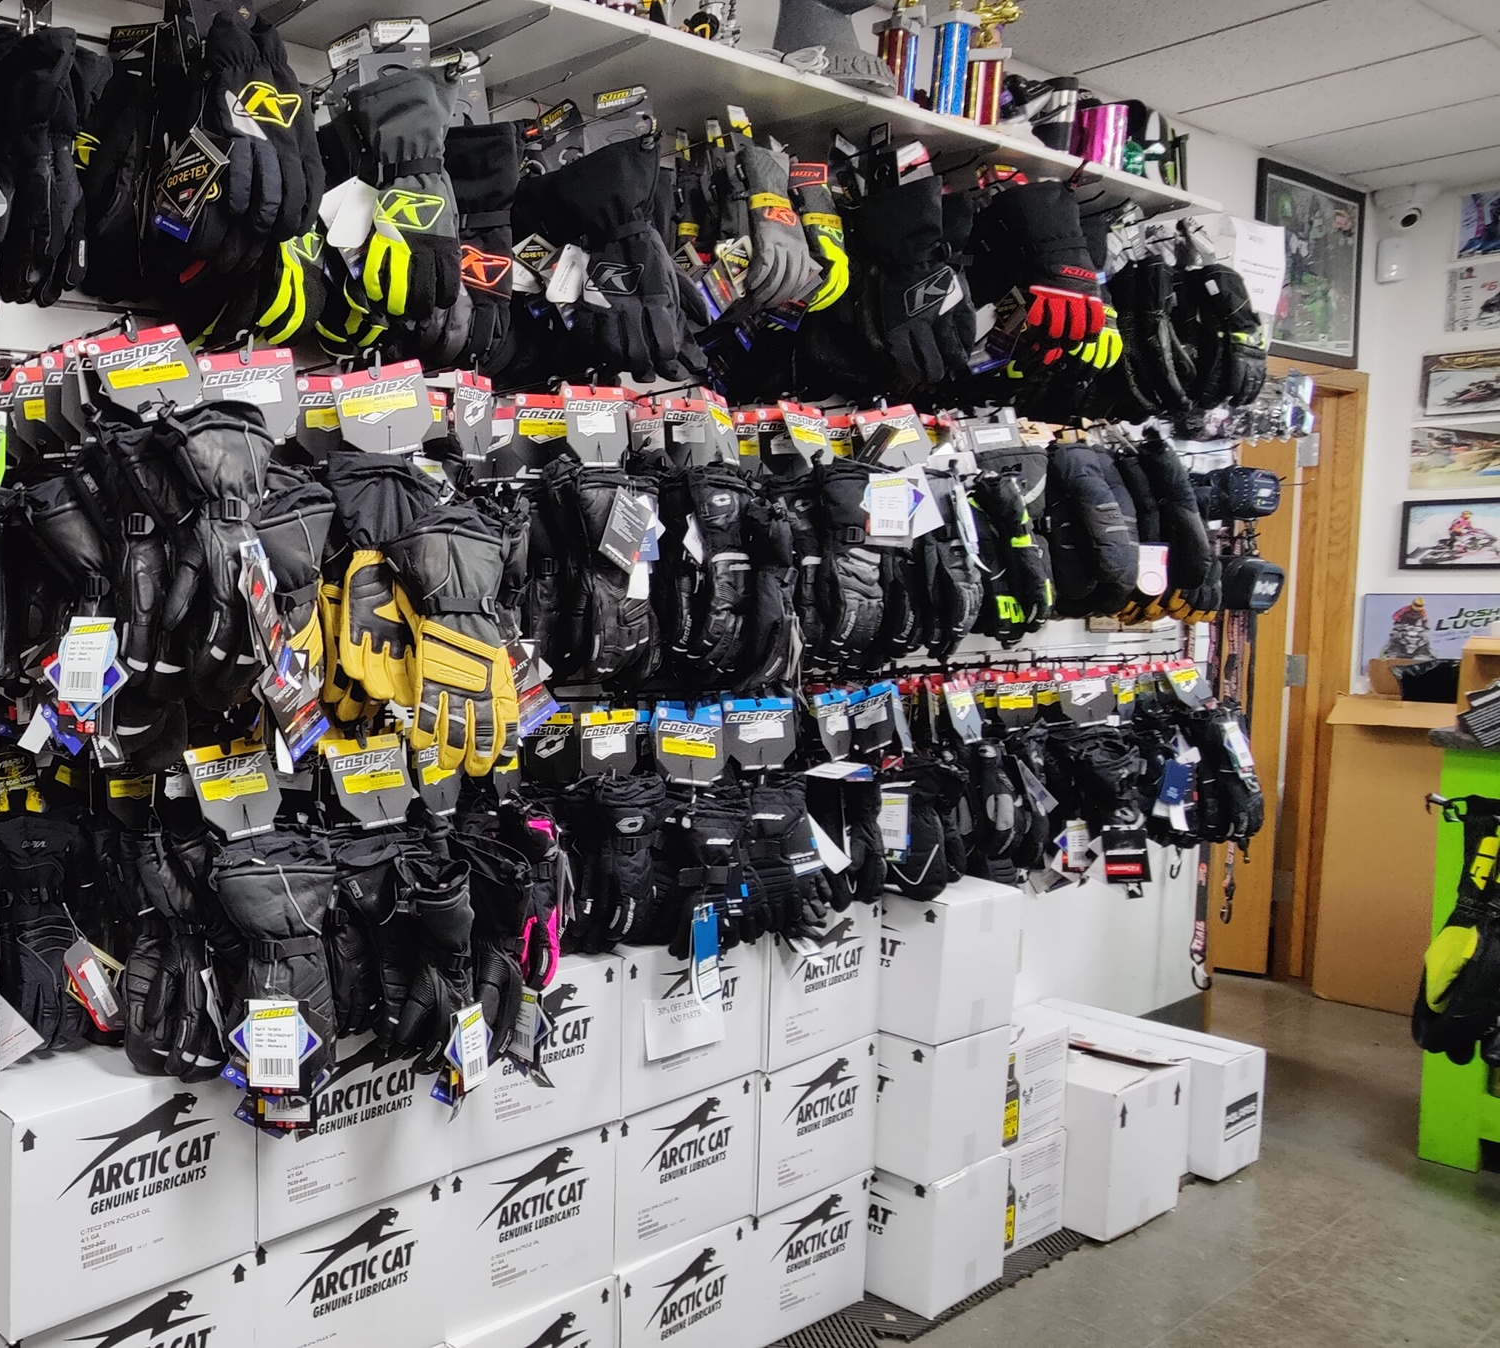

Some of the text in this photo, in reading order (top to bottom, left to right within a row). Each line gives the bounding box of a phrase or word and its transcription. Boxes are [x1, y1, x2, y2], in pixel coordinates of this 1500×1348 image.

[167, 165, 208, 188] GORE-TEX
[844, 946, 865, 967] CAT
[722, 977, 738, 1000] AT
[804, 969, 858, 994] GENUINE LUBRICANTS
[562, 1017, 592, 1045] CAT
[541, 1044, 585, 1065] UBRICANTS
[319, 1076, 383, 1119] ARCTIC
[319, 1095, 413, 1135] GENUINE LUBRICANTS
[796, 1085, 860, 1126] ARCTIC CAT
[797, 1108, 854, 1137] GENUINE LUBRICANTS
[88, 1132, 216, 1199] ARCTIC CAT
[659, 1127, 732, 1172] ARCTIC CAT
[660, 1151, 727, 1184] GENUINE LUBRICANTS
[91, 1165, 207, 1215] GENUINE LUBRICANTS
[497, 1178, 587, 1230] ARCTIC CAT
[141, 1207, 151, 1215] OIL
[499, 1205, 580, 1243] GENUINE LUBRICANTS
[868, 1207, 894, 1225] AT
[785, 1220, 852, 1263] ARCTIC CAT
[786, 1243, 845, 1274] GENUINE LUBRICANTS
[310, 1241, 415, 1304] ARCTIC CAT
[312, 1271, 409, 1319] GENUINE LUBRICANTS
[659, 1274, 727, 1329] ARCTIC CAT
[661, 1300, 722, 1341] GENUINE LUBRICANTS
